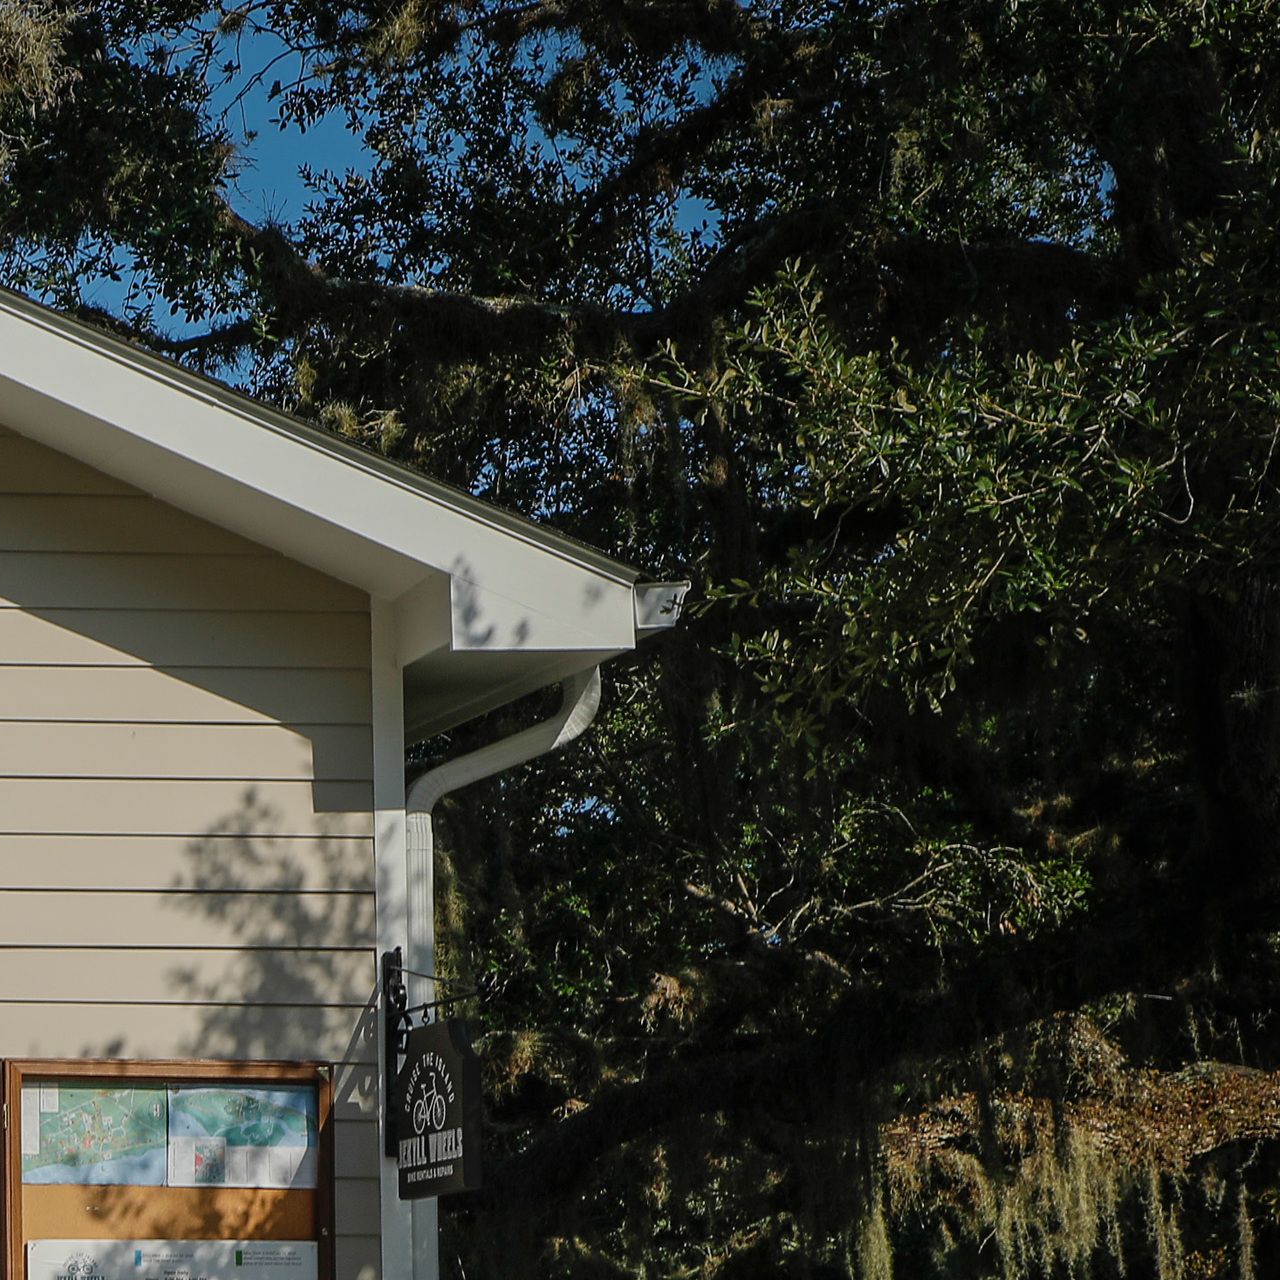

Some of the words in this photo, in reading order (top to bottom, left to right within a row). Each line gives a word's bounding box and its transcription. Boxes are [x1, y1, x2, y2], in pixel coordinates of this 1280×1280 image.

[405, 1062, 421, 1113] CRUISE
[422, 1052, 434, 1068] THE
[435, 1055, 455, 1103] ISLAND
[398, 1135, 427, 1168] JEKYLL
[428, 1127, 463, 1163] WHEELS
